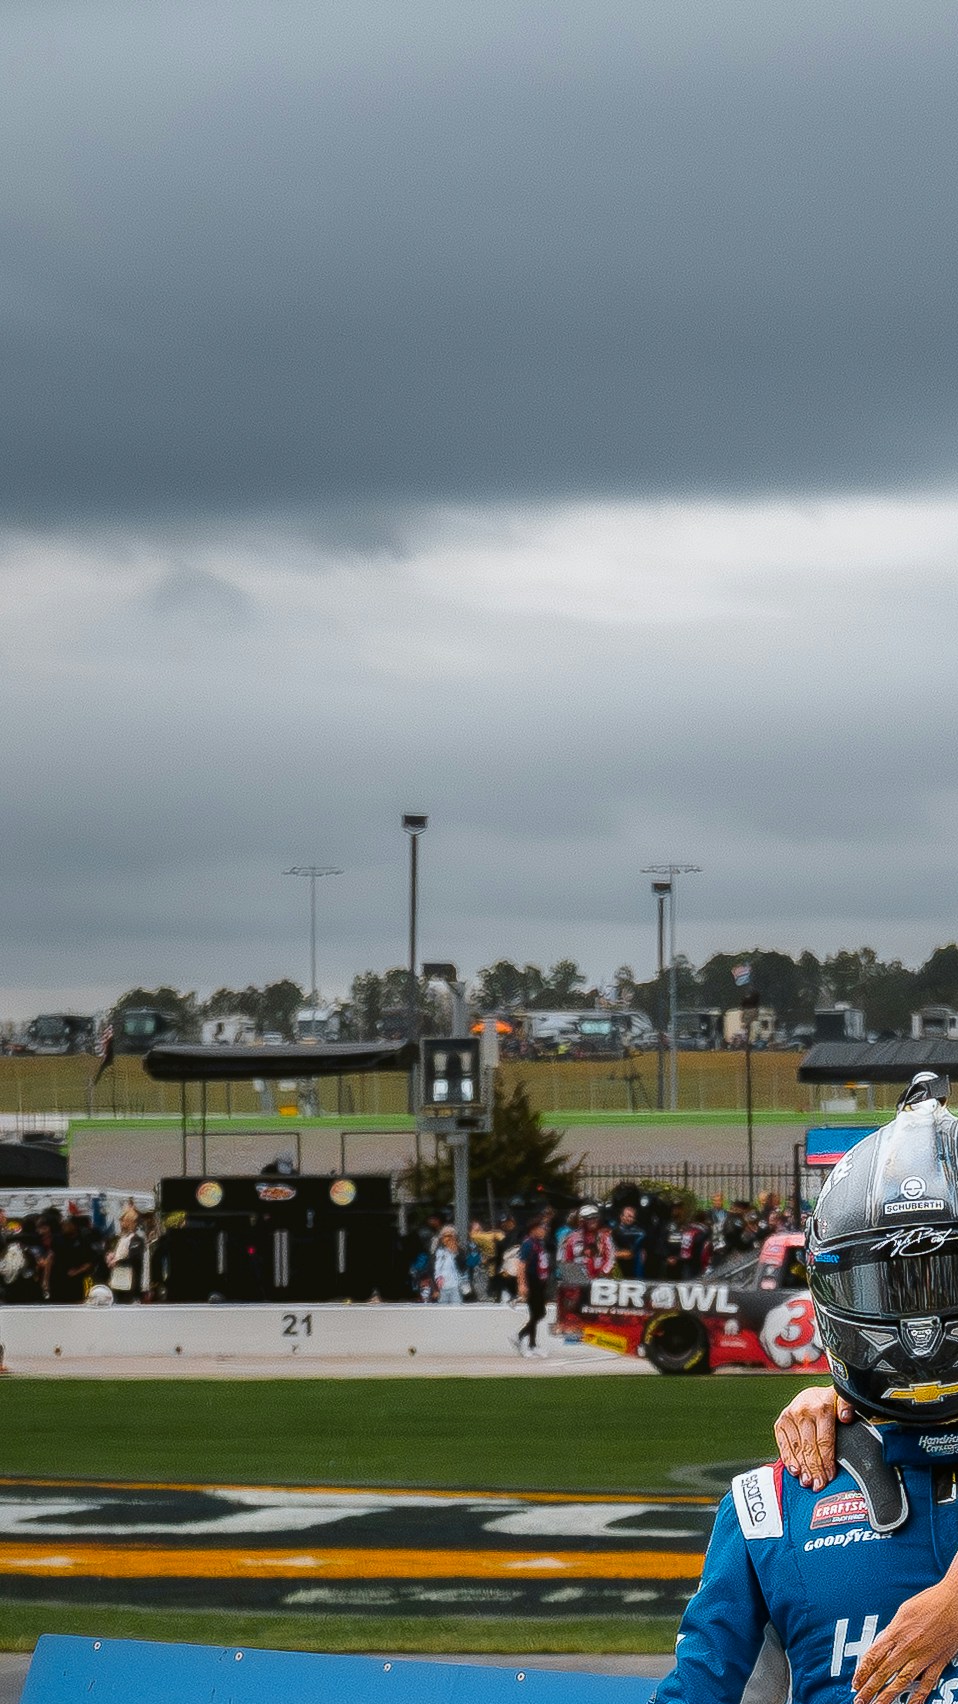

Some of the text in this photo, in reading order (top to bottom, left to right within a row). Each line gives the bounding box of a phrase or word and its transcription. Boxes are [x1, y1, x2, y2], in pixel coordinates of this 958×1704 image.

[886, 1201, 943, 1213] SCHUBERTH
[282, 1313, 312, 1336] 21
[775, 1299, 817, 1348] 3
[815, 1500, 868, 1518] CRAFTSM
